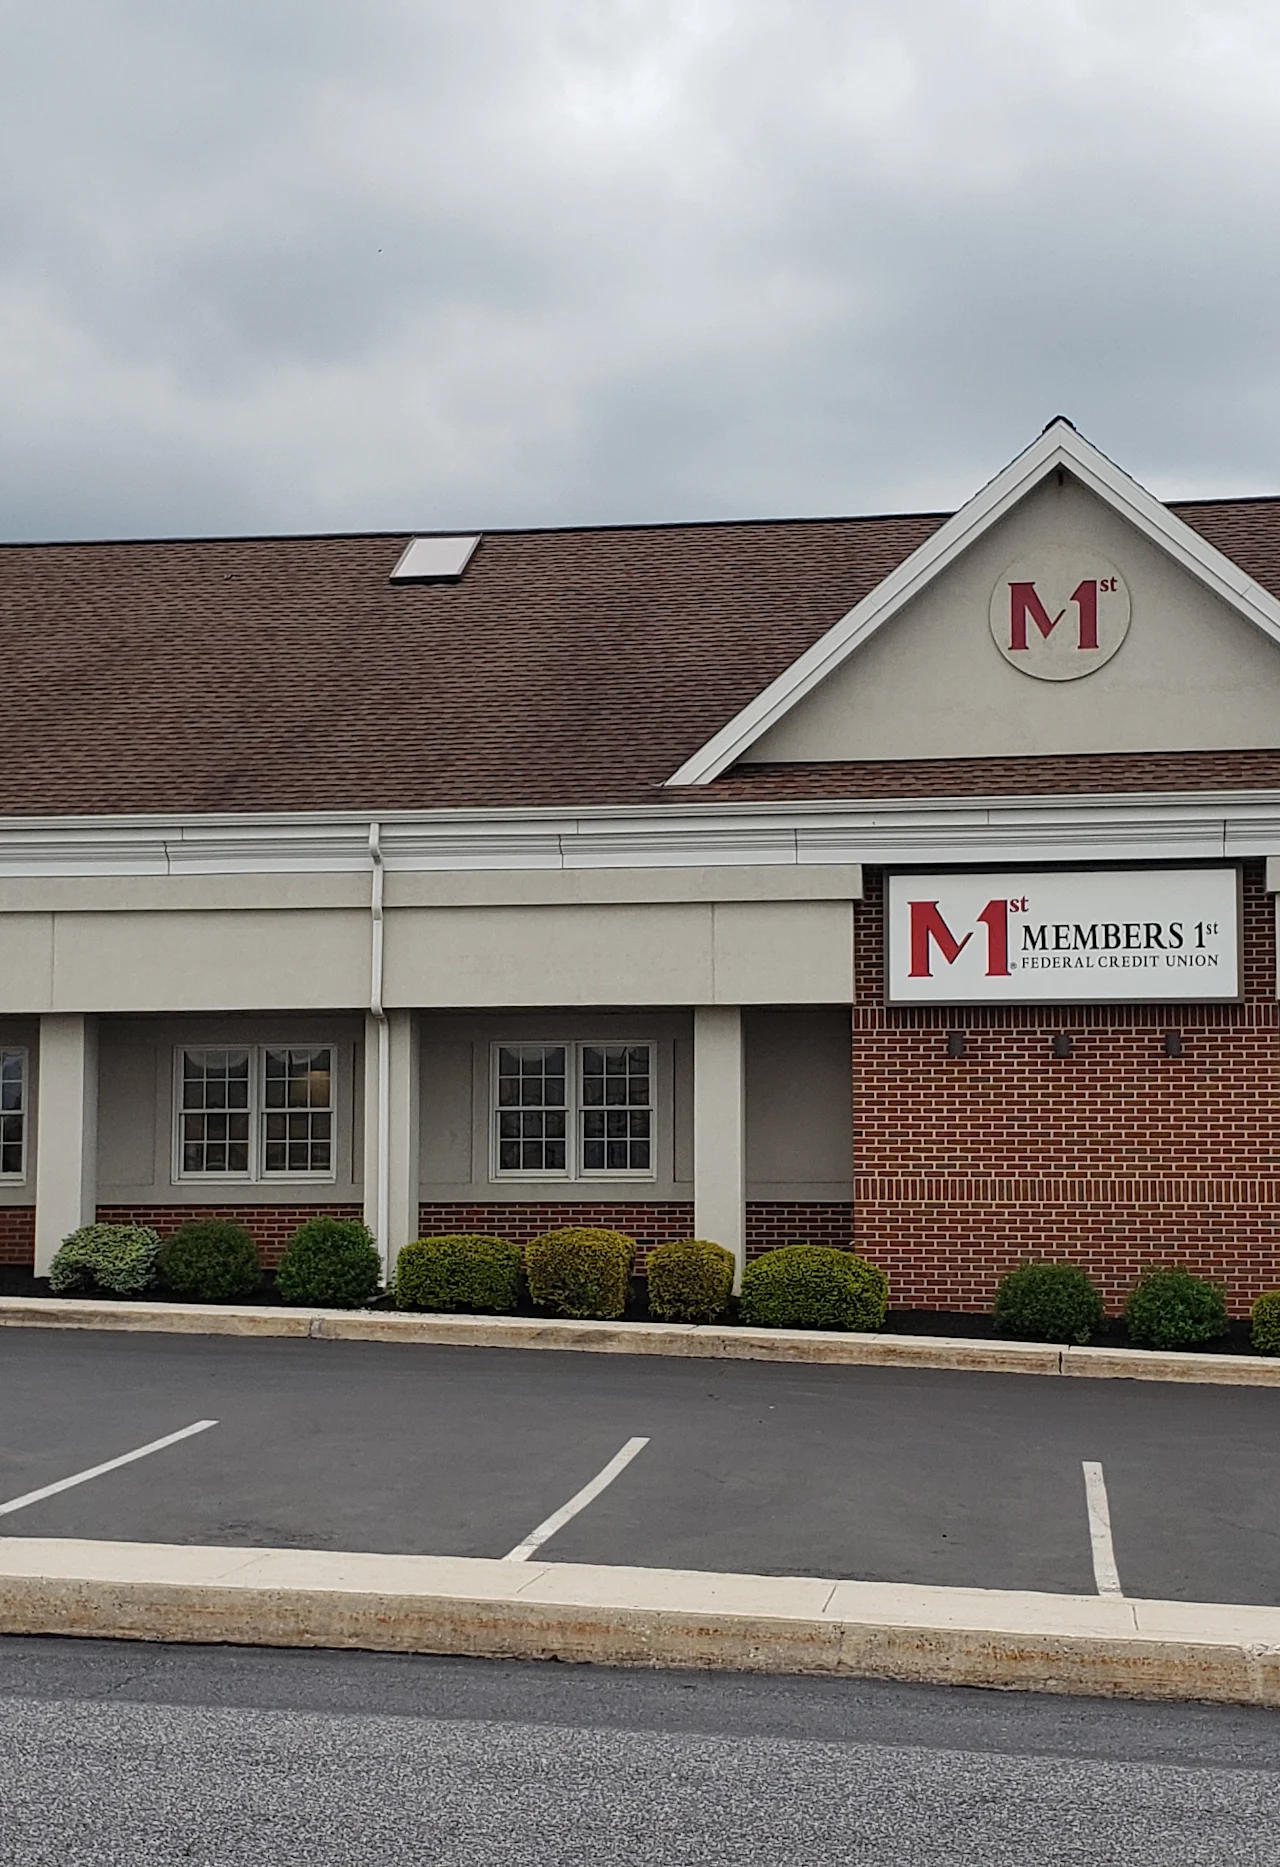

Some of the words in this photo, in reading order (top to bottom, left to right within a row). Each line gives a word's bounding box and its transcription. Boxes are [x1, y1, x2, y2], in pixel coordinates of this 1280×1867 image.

[1021, 922, 1184, 950] MEMBERS
[1194, 921, 1218, 948] 1st
[1021, 956, 1094, 969] FEDERAL
[1098, 955, 1159, 968] CREDIT
[1165, 954, 1219, 967] UNION
